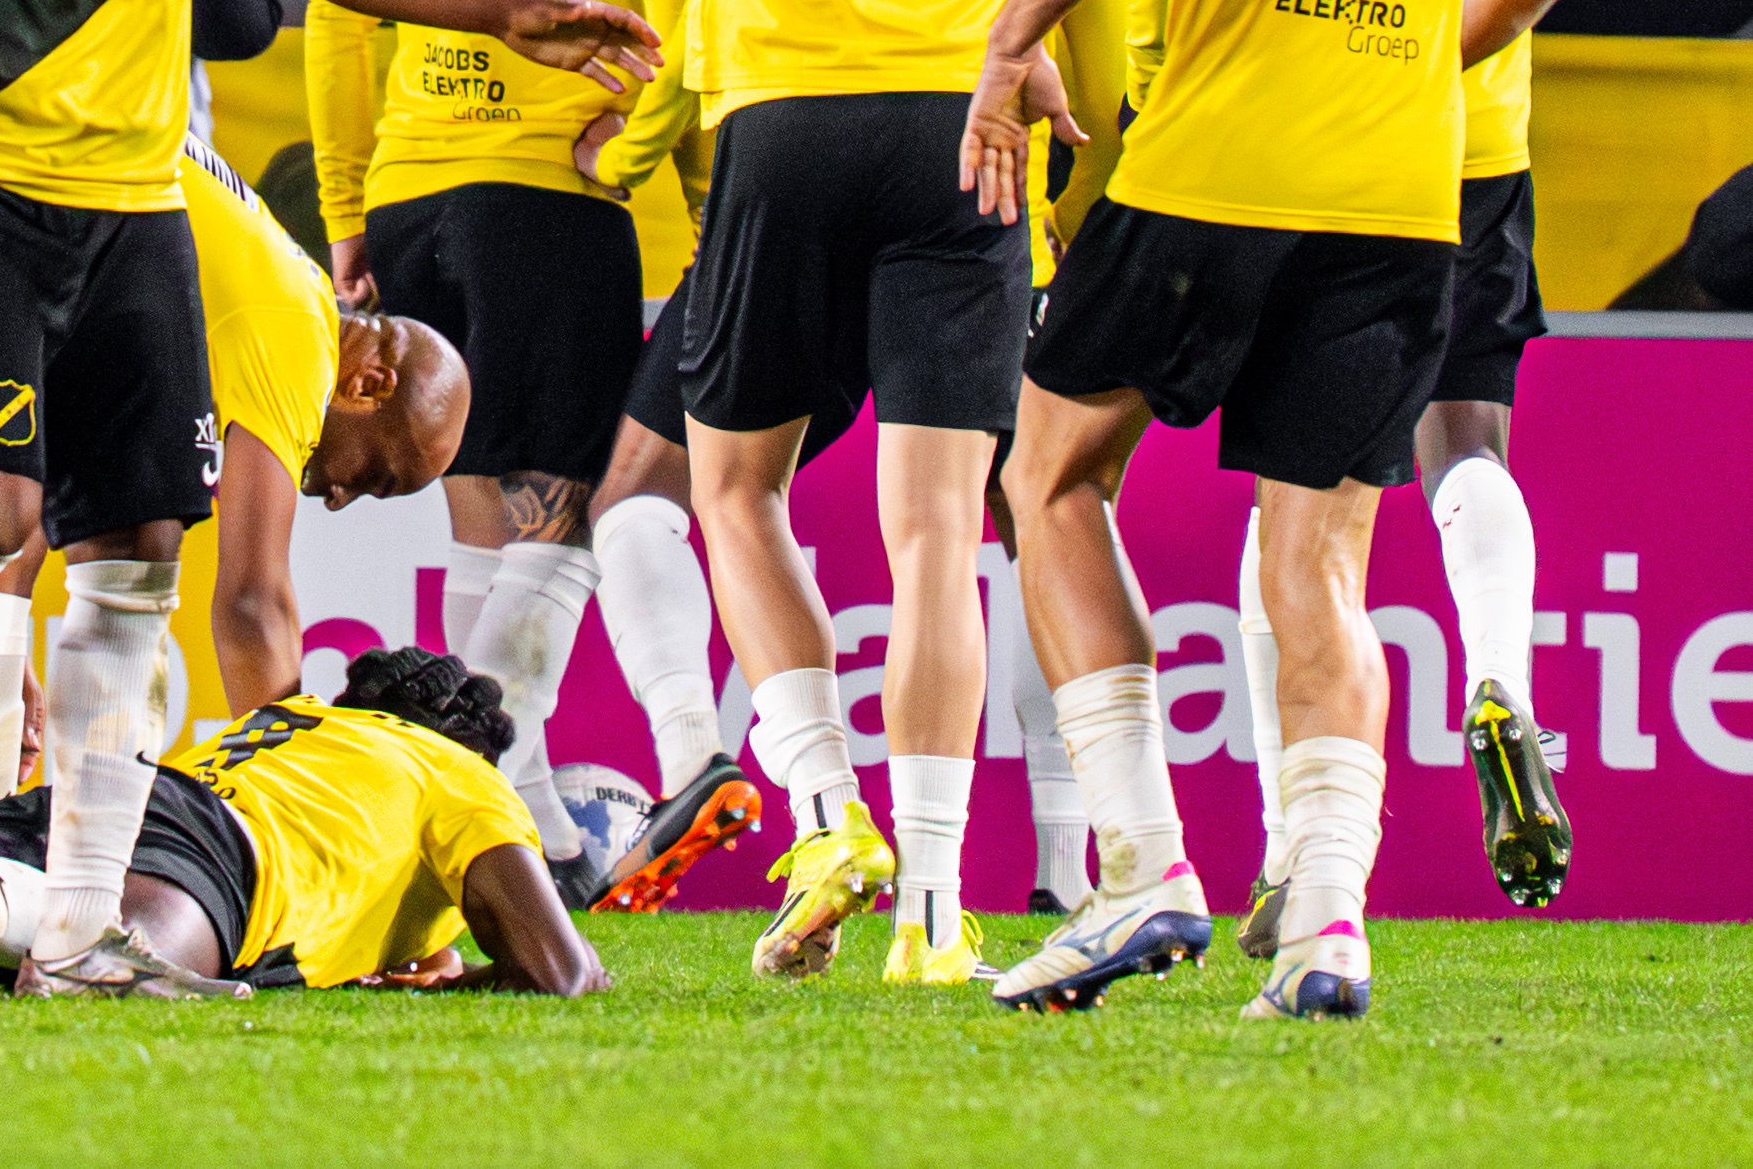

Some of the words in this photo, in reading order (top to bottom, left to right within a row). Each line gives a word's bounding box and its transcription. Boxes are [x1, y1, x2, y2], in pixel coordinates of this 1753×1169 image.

[424, 42, 491, 73] JACOBS
[1346, 25, 1420, 66] Groep
[422, 71, 506, 103] ELEKTRO
